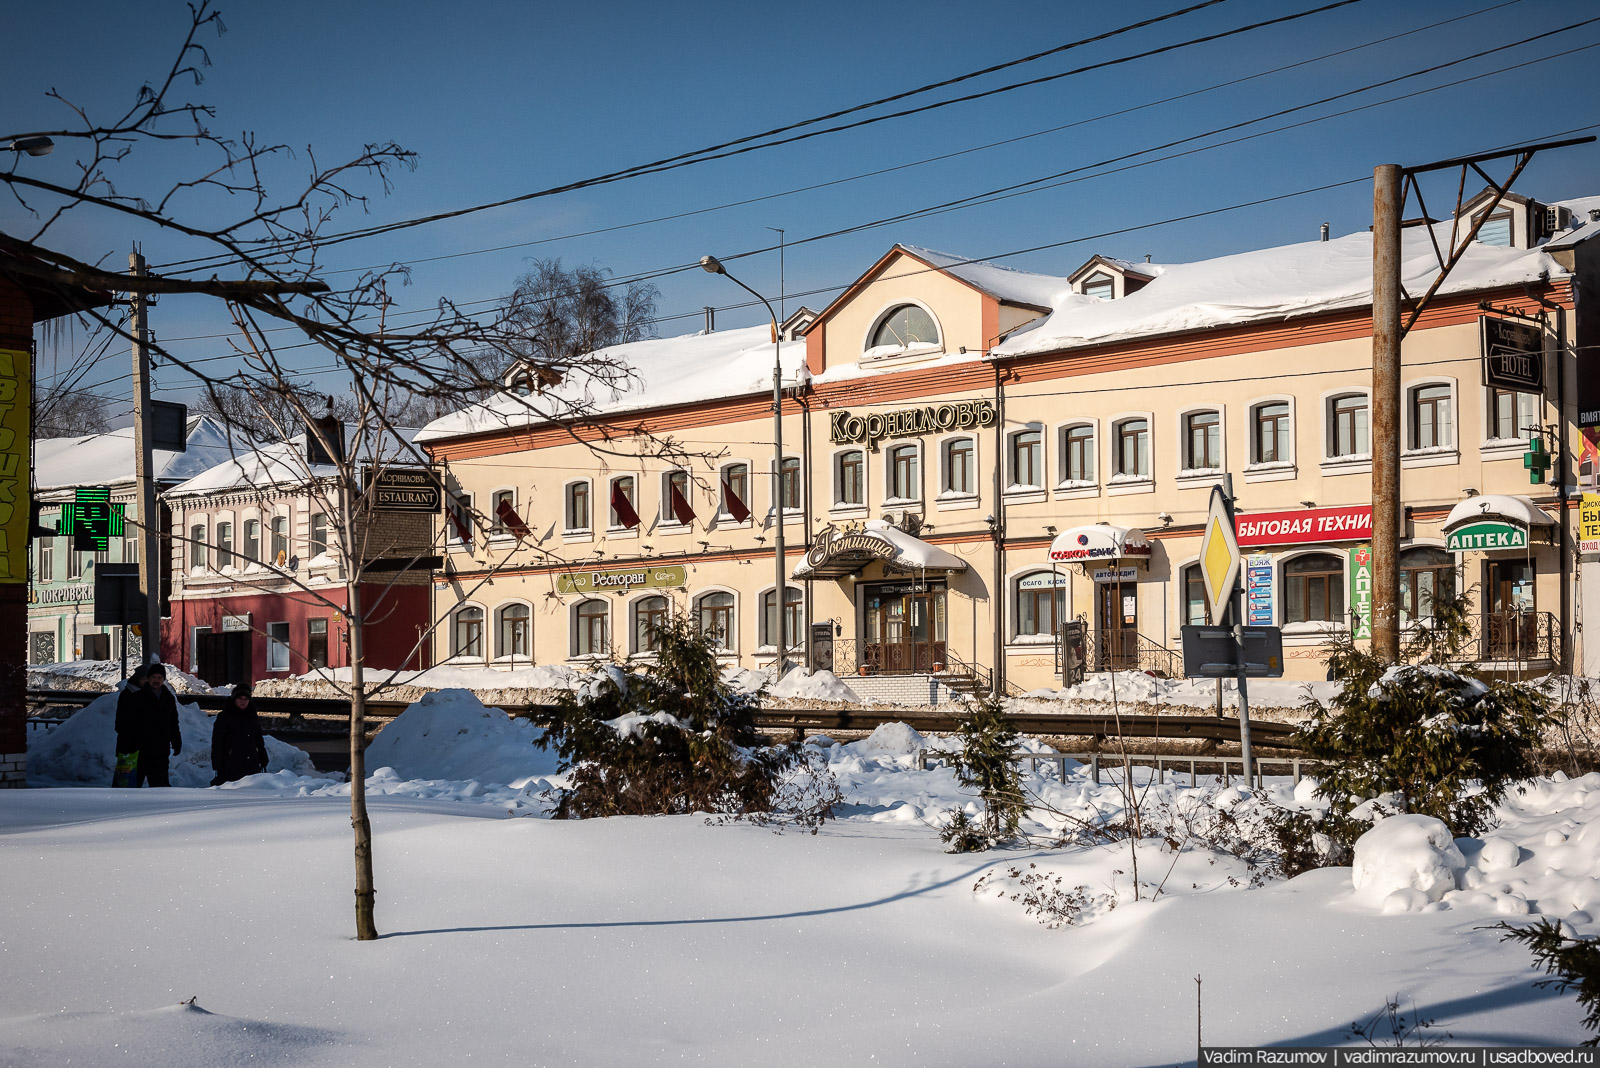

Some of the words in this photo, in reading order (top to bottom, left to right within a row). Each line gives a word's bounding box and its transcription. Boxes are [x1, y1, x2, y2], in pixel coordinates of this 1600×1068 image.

[1500, 353, 1532, 376] HOTEL
[375, 491, 435, 503] ESTAURANT
[1238, 518, 1313, 537] БЫТОВАЯ
[1317, 513, 1372, 532] ТЕХНИ
[808, 522, 895, 567] Гостиница
[1450, 532, 1523, 549] АПТЕКА
[1581, 541, 1598, 551] ВХОД
[592, 573, 646, 589] Ресторан
[1355, 567, 1371, 637] АПТЕКА
[1069, 668, 1082, 681] 24
